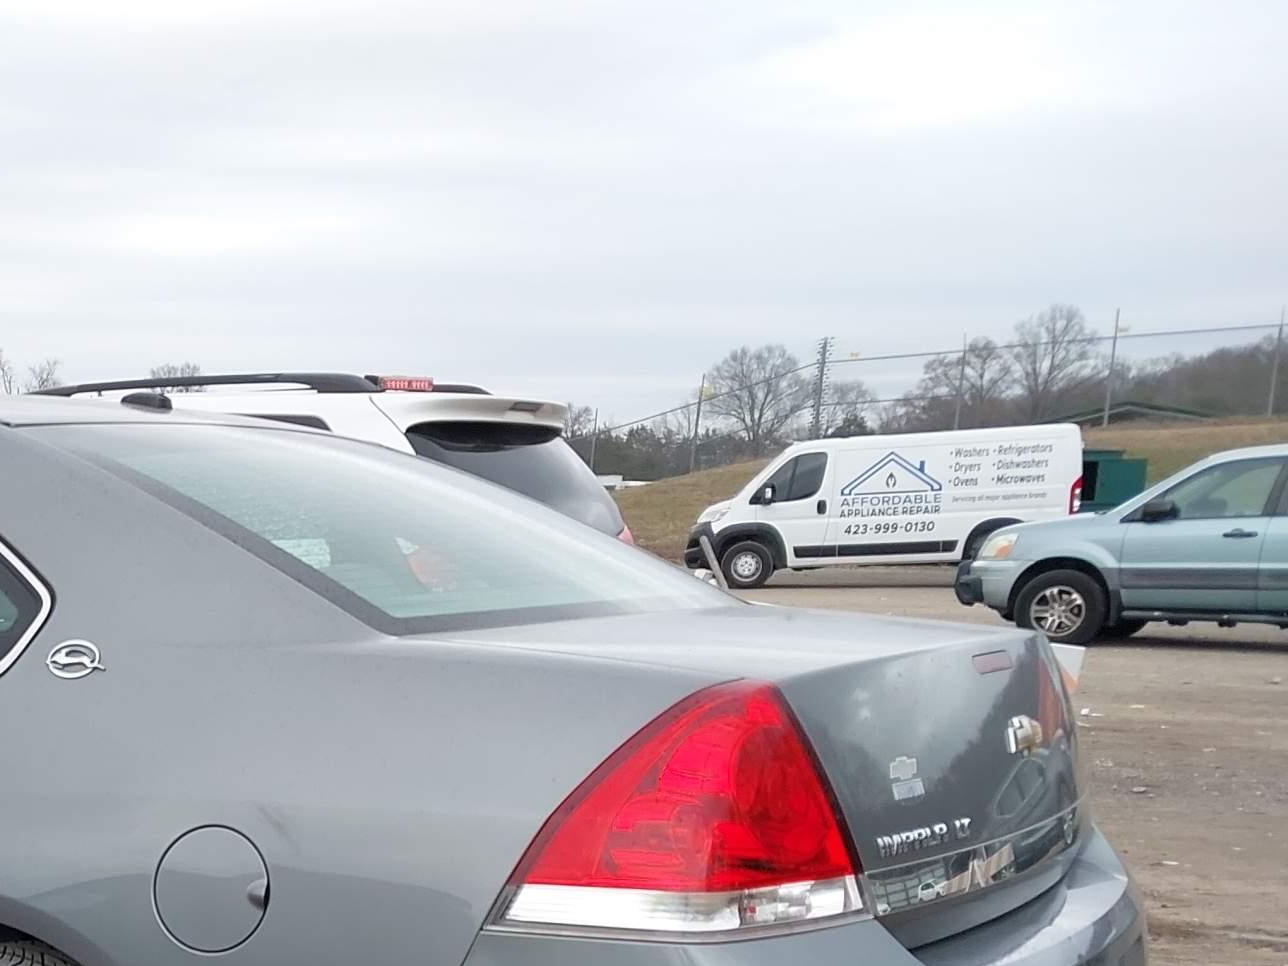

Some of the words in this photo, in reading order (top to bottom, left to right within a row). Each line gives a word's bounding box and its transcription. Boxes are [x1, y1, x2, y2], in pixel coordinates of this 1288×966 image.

[954, 447, 989, 458] Washers
[998, 444, 1053, 457] Refrigerators
[954, 462, 981, 474] Dryers
[996, 459, 1048, 470] Dishwashers
[953, 476, 978, 487] Ovens
[996, 474, 1045, 485] Microwaves
[840, 493, 942, 508] AFFORDABLE
[840, 505, 899, 519] APPLIANCE
[901, 504, 941, 516] REPAIR
[844, 520, 935, 535] 423-999-0130
